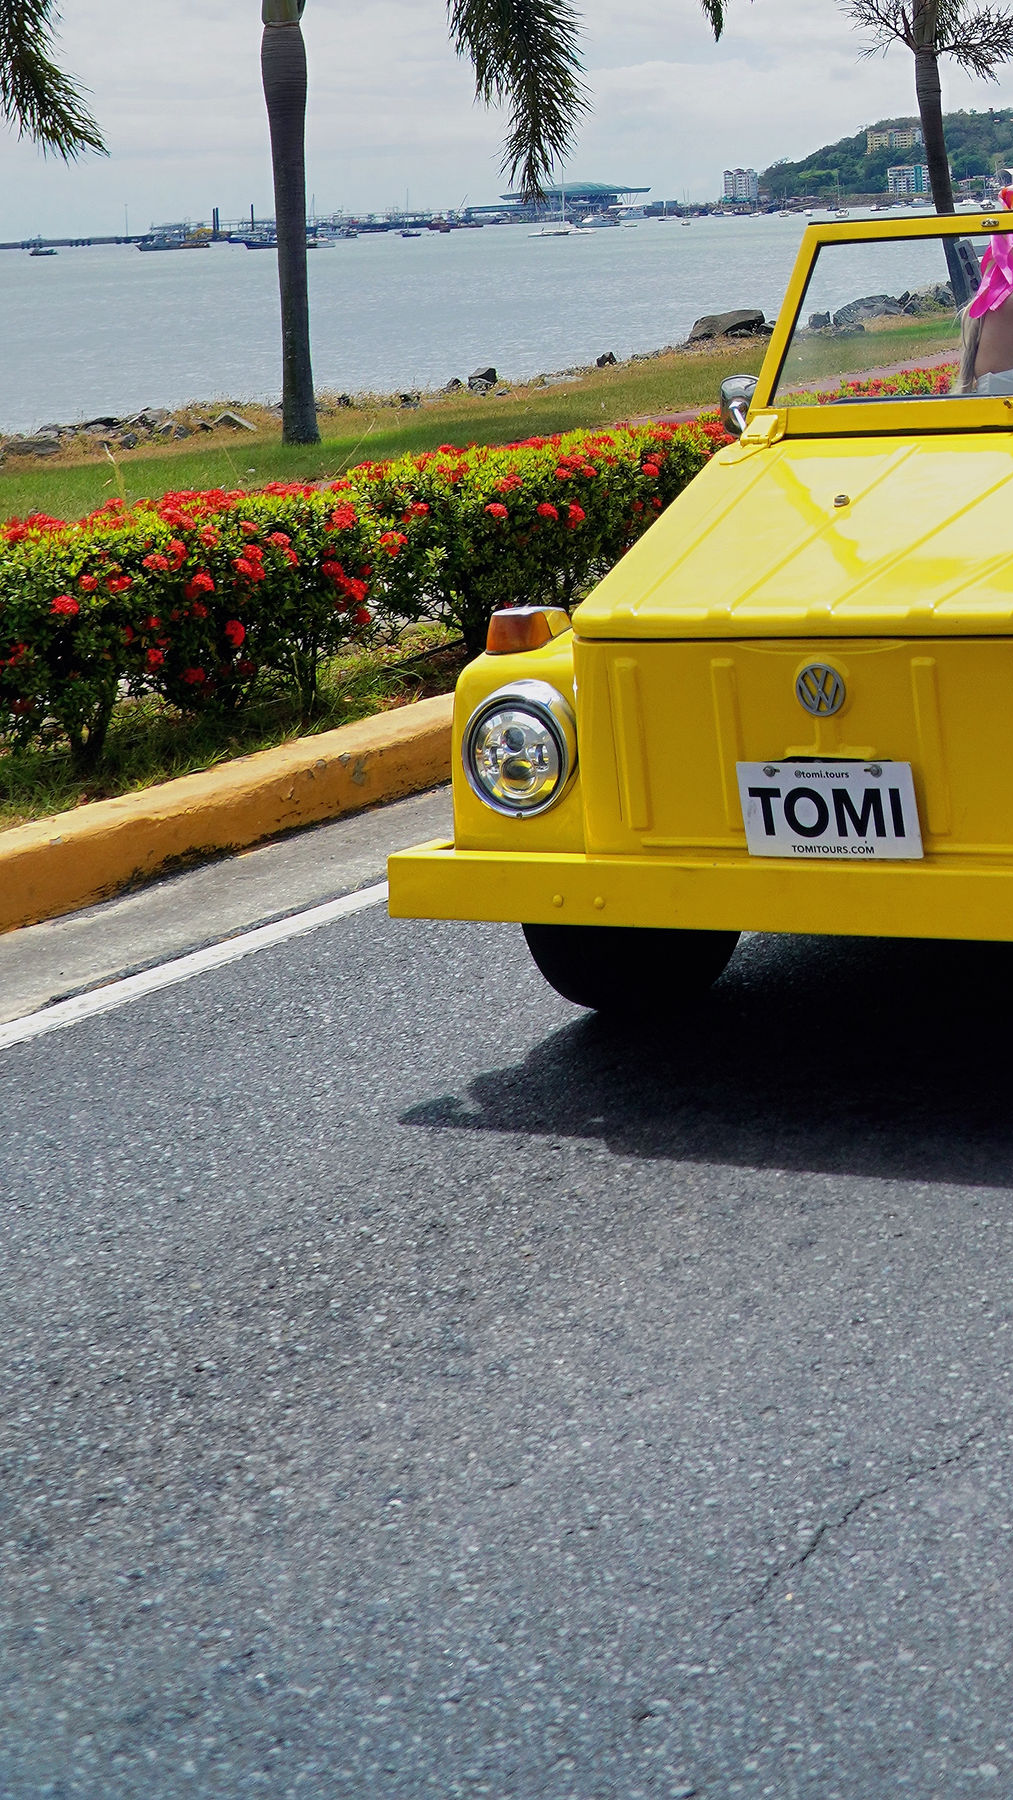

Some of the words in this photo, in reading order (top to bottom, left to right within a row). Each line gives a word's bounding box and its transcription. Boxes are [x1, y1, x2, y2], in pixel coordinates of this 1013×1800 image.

[796, 663, 846, 717] VW
[794, 770, 850, 779] @tomi.tours
[748, 786, 906, 838] TOMI
[791, 845, 875, 854] TOMITOURS.COM
